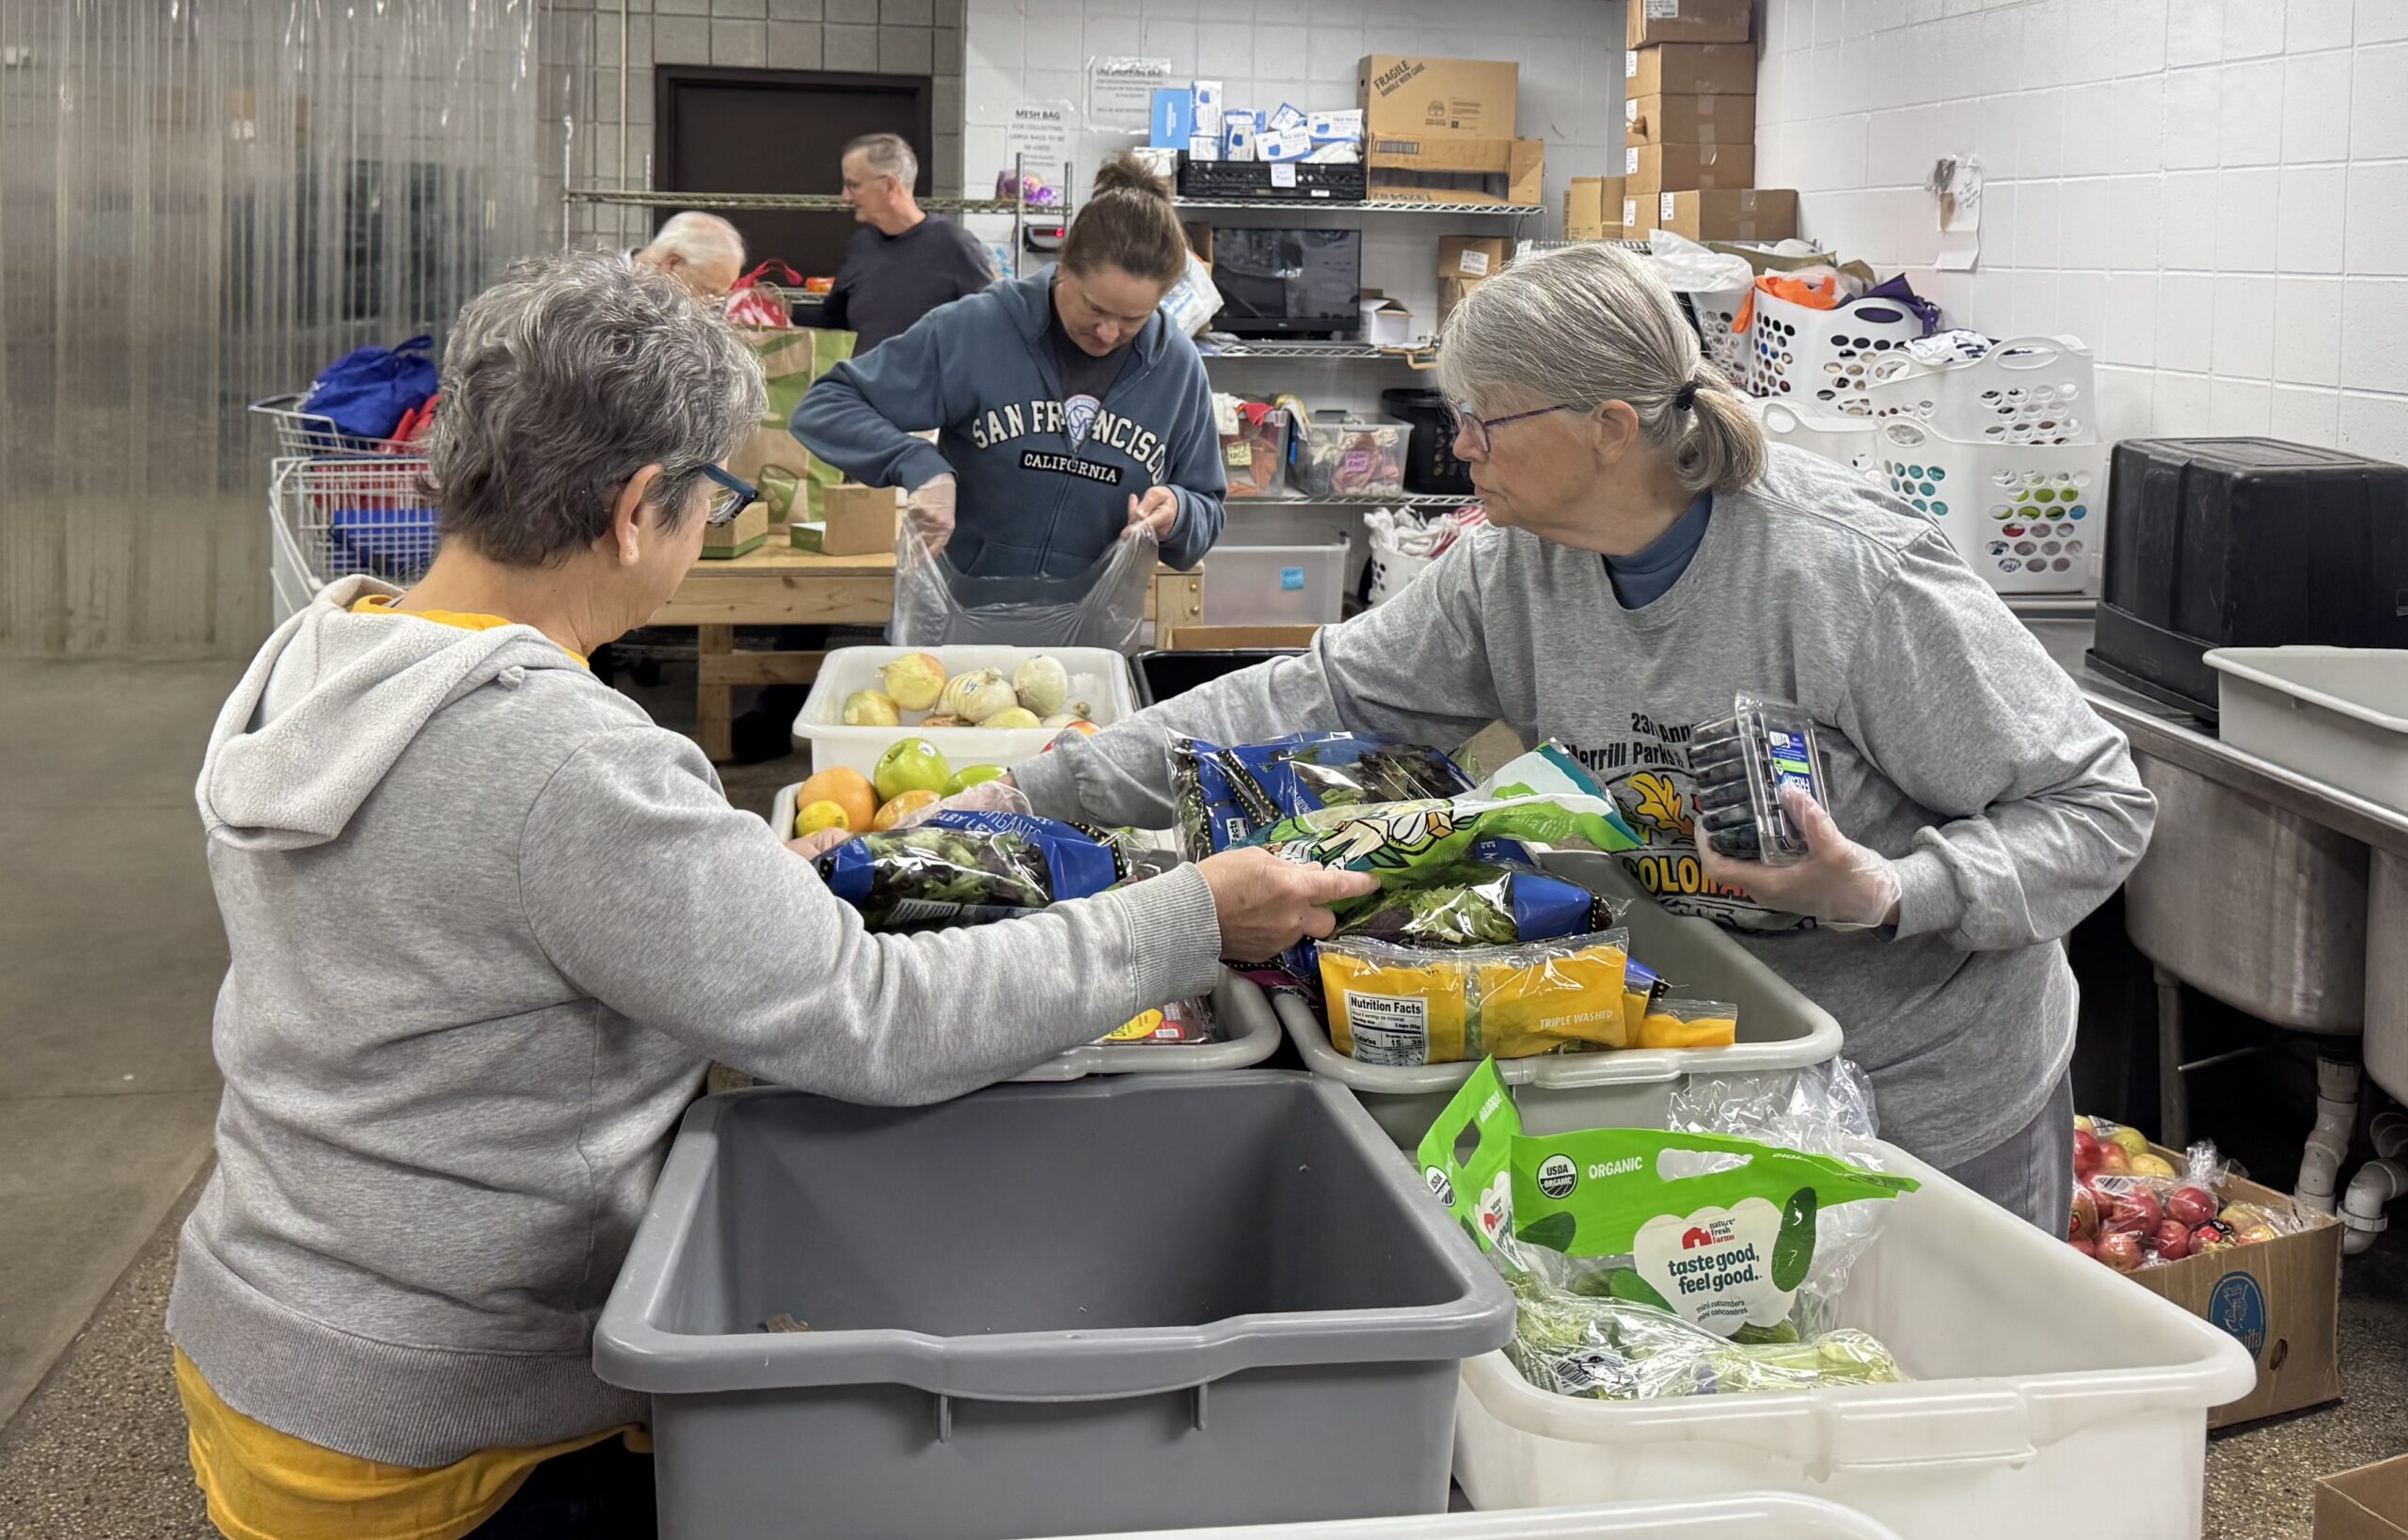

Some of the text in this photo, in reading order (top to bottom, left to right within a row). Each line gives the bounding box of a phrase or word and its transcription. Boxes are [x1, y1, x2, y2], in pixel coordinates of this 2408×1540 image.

[1373, 59, 1411, 90] FRAGILE
[1016, 109, 1060, 121] MESH BAG
[972, 403, 1025, 450] SAN
[1023, 452, 1117, 484] CALIFORNIA
[1633, 741, 1674, 766] Parks
[1351, 996, 1421, 1014] Nutrition Facts
[1540, 1009, 1613, 1028] TRIPLE WASHED
[1546, 1164, 1569, 1176] USDA
[1589, 1156, 1643, 1180] ORGANIC
[1544, 1176, 1573, 1188] ORGANIC
[1711, 1227, 1731, 1236] fresh
[1712, 1233, 1735, 1244] farms
[1668, 1243, 1760, 1277] taste good,
[1678, 1272, 1711, 1294] feel
[1696, 1299, 1745, 1313] mini cucumbers
[1697, 1307, 1748, 1323] mini concombres
